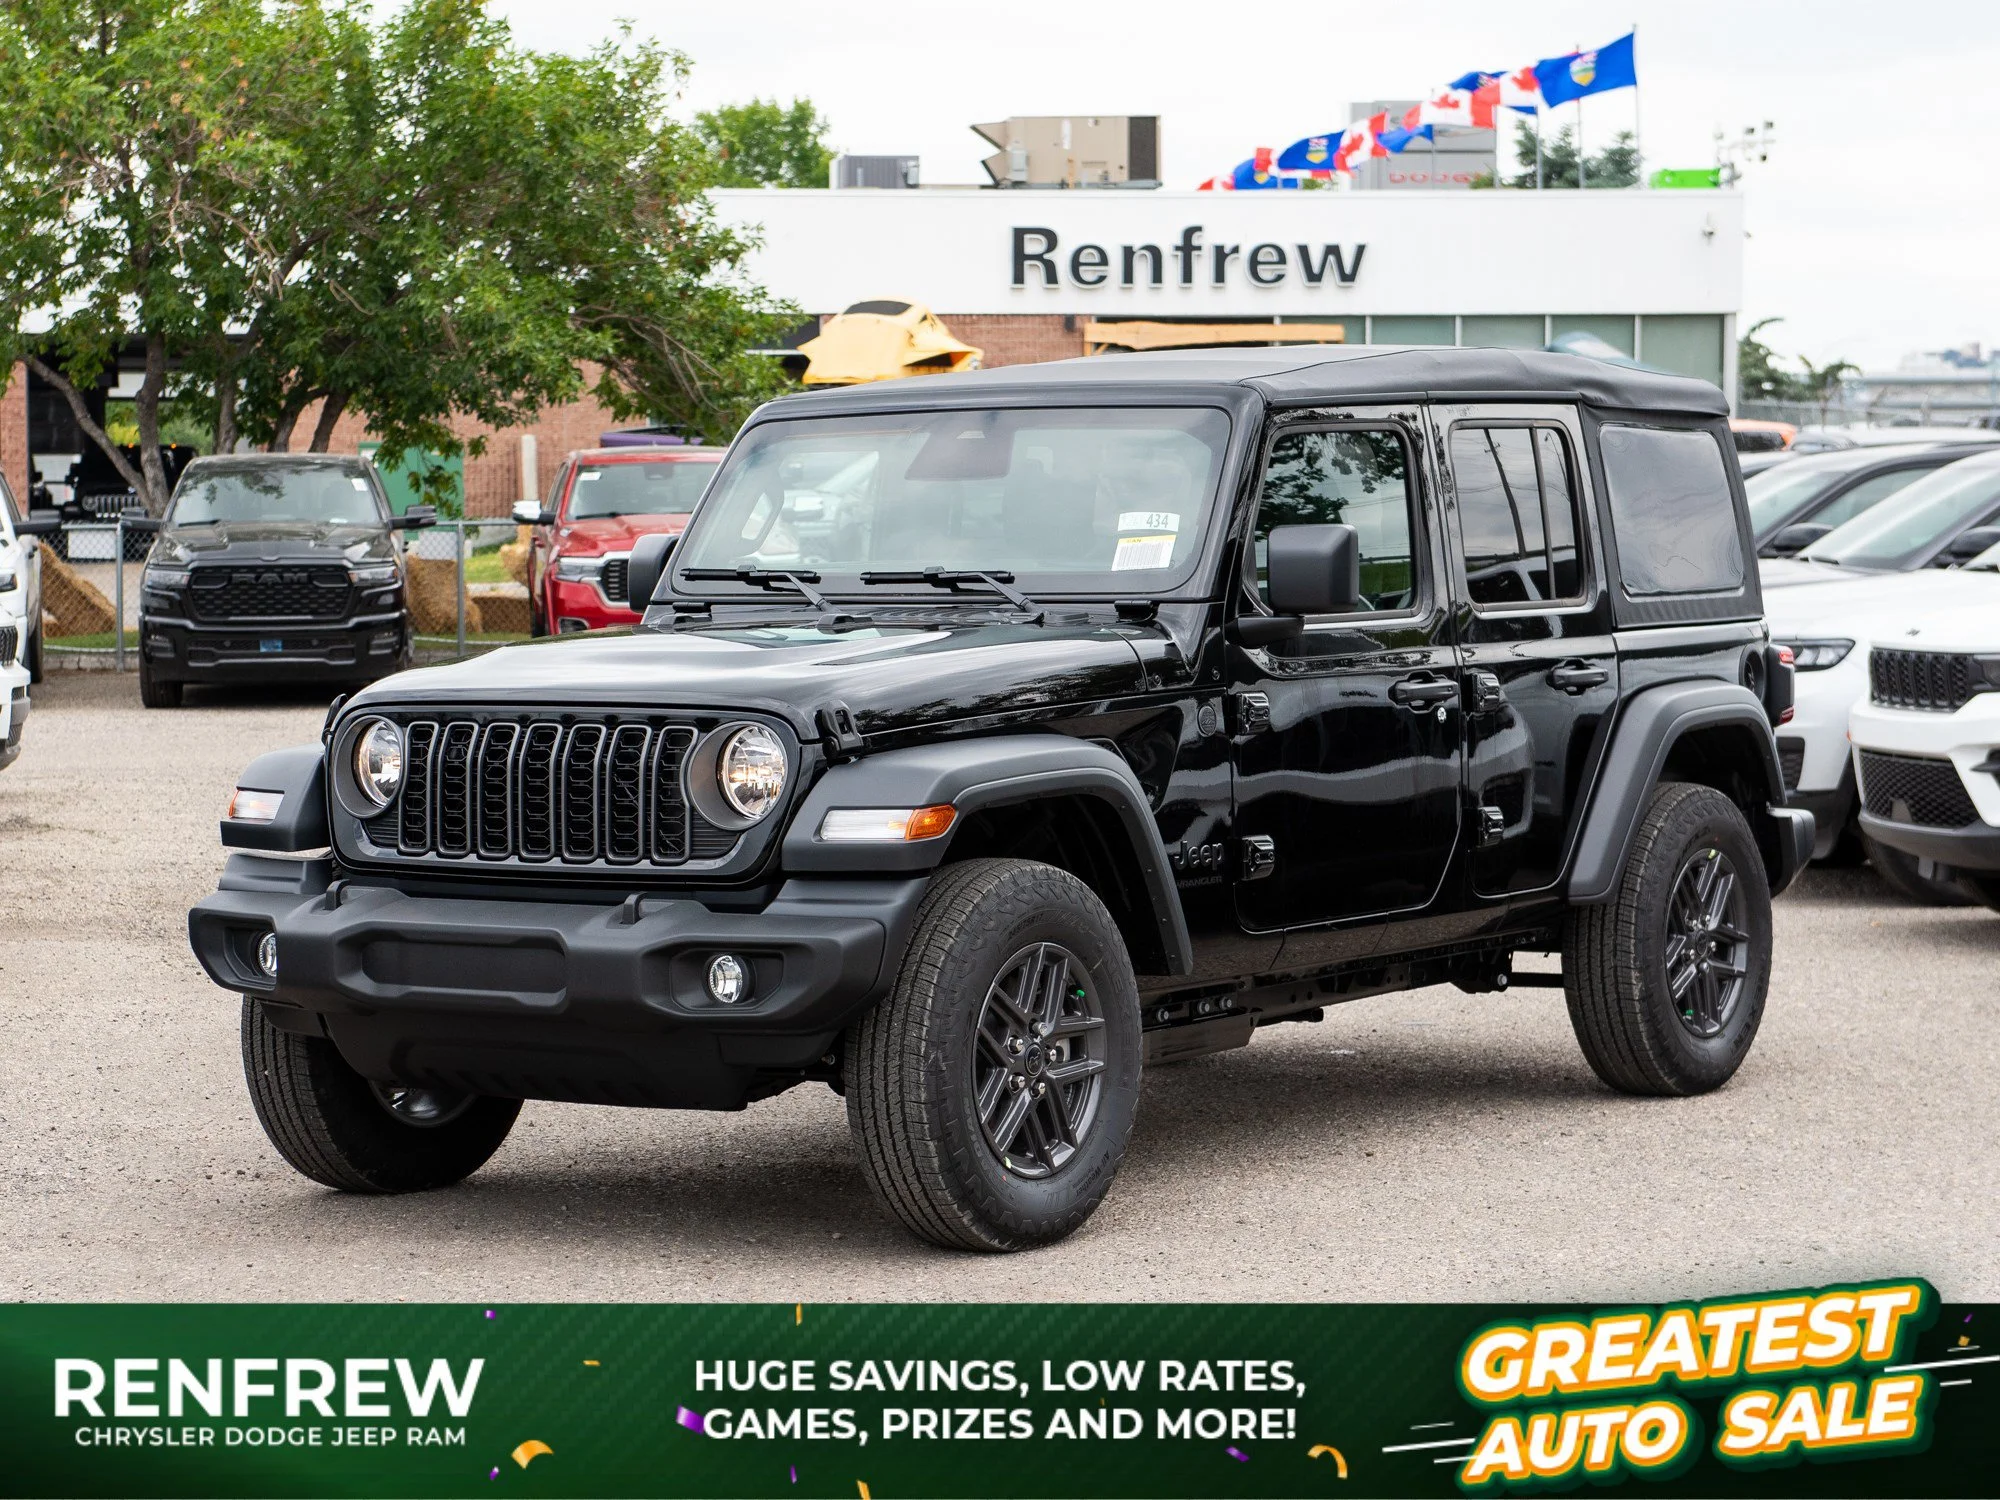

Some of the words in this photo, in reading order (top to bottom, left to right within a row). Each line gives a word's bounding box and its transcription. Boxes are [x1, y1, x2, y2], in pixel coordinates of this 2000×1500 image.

[1011, 226, 1366, 288] Renfrew
[1146, 513, 1169, 528] 434
[231, 572, 309, 585] RAM
[1173, 840, 1225, 871] Jeep
[1176, 875, 1223, 889] WRANGLER
